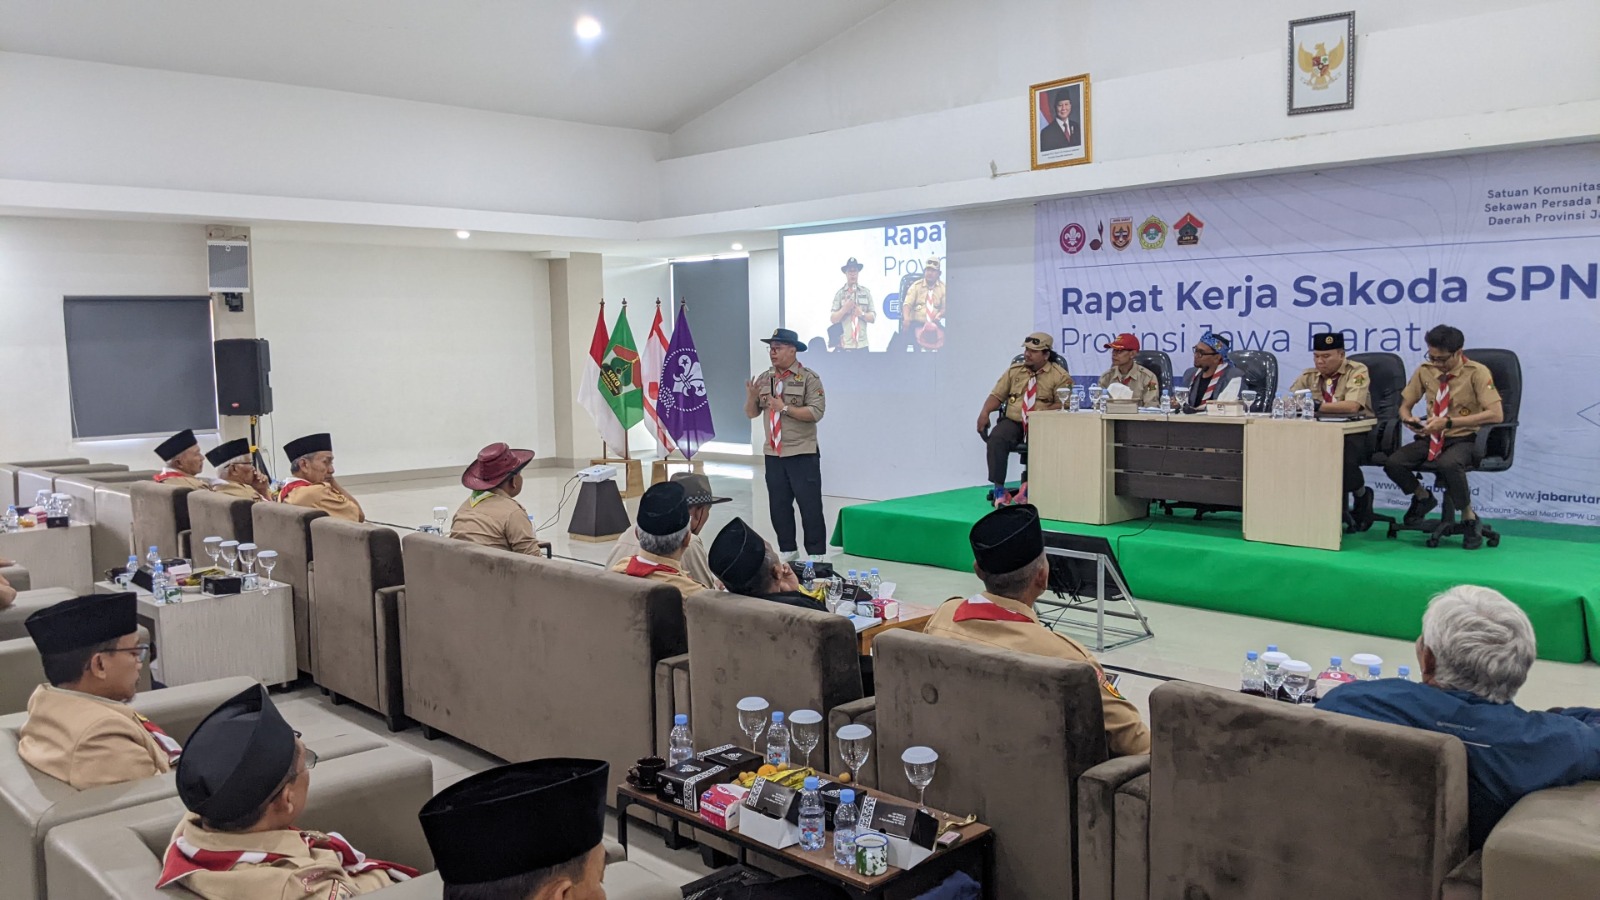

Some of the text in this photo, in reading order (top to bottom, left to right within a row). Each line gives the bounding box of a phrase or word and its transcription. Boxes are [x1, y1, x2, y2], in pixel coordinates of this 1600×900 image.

[1487, 183, 1600, 199] Satuan Komunitas
[1484, 202, 1537, 213] Sekawan
[1541, 196, 1592, 208] Persada
[1488, 214, 1531, 226] Daerah
[1535, 210, 1586, 222] Provinsi
[884, 223, 946, 249] Rapa
[1062, 263, 1599, 321] Rapat Kerja Sakoda SPN
[1513, 508, 1538, 516] Social
